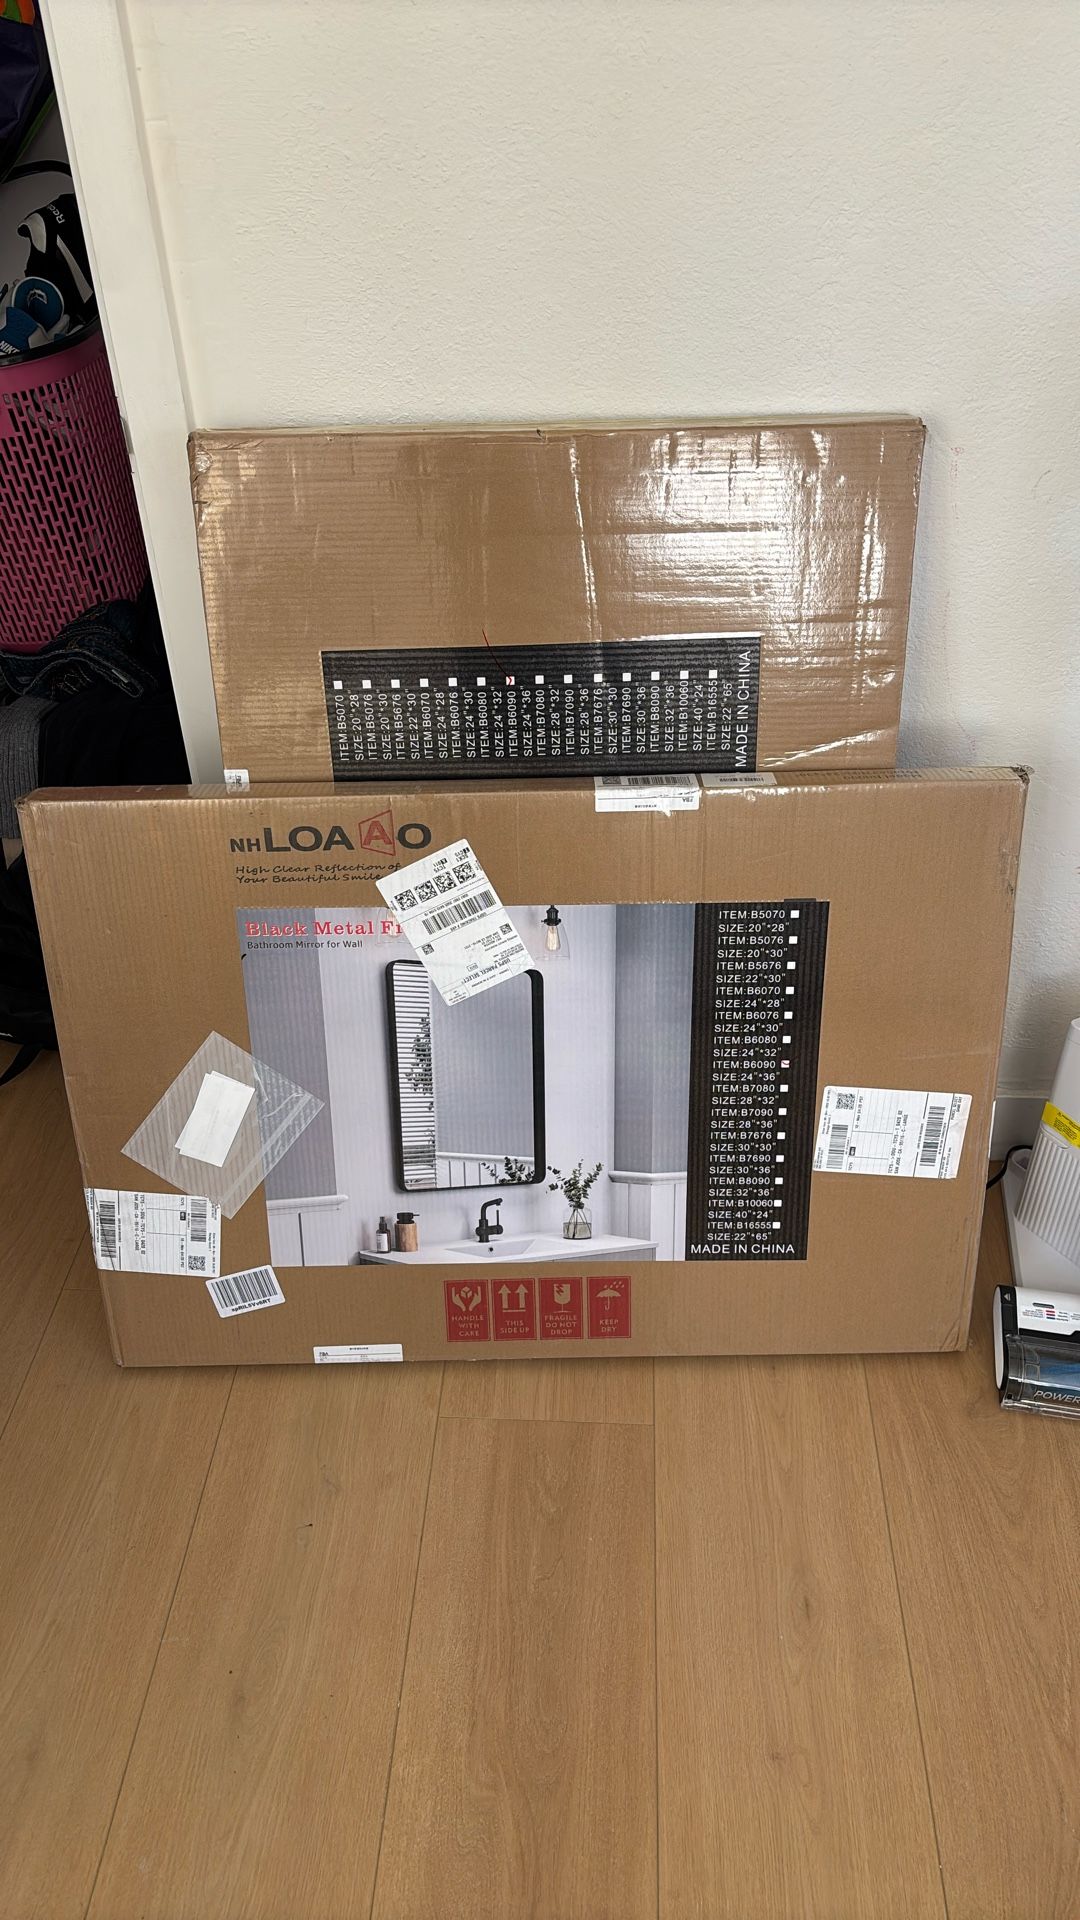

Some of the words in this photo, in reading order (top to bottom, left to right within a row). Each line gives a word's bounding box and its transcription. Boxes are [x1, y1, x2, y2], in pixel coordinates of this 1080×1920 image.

[738, 651, 750, 700] CHINA
[335, 695, 349, 760] ITEM:B5070
[364, 694, 377, 760] ITEM:B5076
[392, 694, 405, 760] ITEM:B5676
[421, 693, 433, 758] ITEM:B6070
[449, 692, 461, 758] ITEM:B6076
[478, 692, 489, 758] ITEM:B6080
[507, 691, 518, 756] ITEM:B6090
[536, 690, 546, 756] ITEM:B7080
[565, 689, 574, 755] ITEM:B7090
[594, 688, 602, 754] ITEM:B7676
[622, 687, 631, 753] ITEM:B7690
[651, 686, 660, 752] ITEM:B8090
[679, 681, 688, 751] ITEM:B10060
[707, 680, 718, 750] ITEM:B16555
[737, 705, 748, 719] IN
[735, 724, 748, 766] MADE
[236, 866, 270, 875] High
[272, 865, 310, 873] Clear
[315, 864, 385, 873] Reflection
[388, 862, 401, 871] of
[236, 876, 267, 884] Your
[272, 874, 340, 883] Beautiful
[245, 921, 308, 936] Black
[314, 921, 374, 936] Metal
[719, 911, 785, 919] ITEM:B5070
[247, 941, 293, 949] Bathroom
[718, 936, 783, 945] ITEM:B5076
[480, 963, 498, 976] PARCEL
[717, 962, 781, 970] ITEM:B5676
[716, 987, 780, 995] ITEM:B6070
[714, 1036, 777, 1044] ITEM:B6080
[715, 1012, 779, 1020] ITEM:B6076
[691, 1244, 730, 1254] MADE
[734, 1244, 747, 1253] IN
[751, 1244, 795, 1253] CHINA
